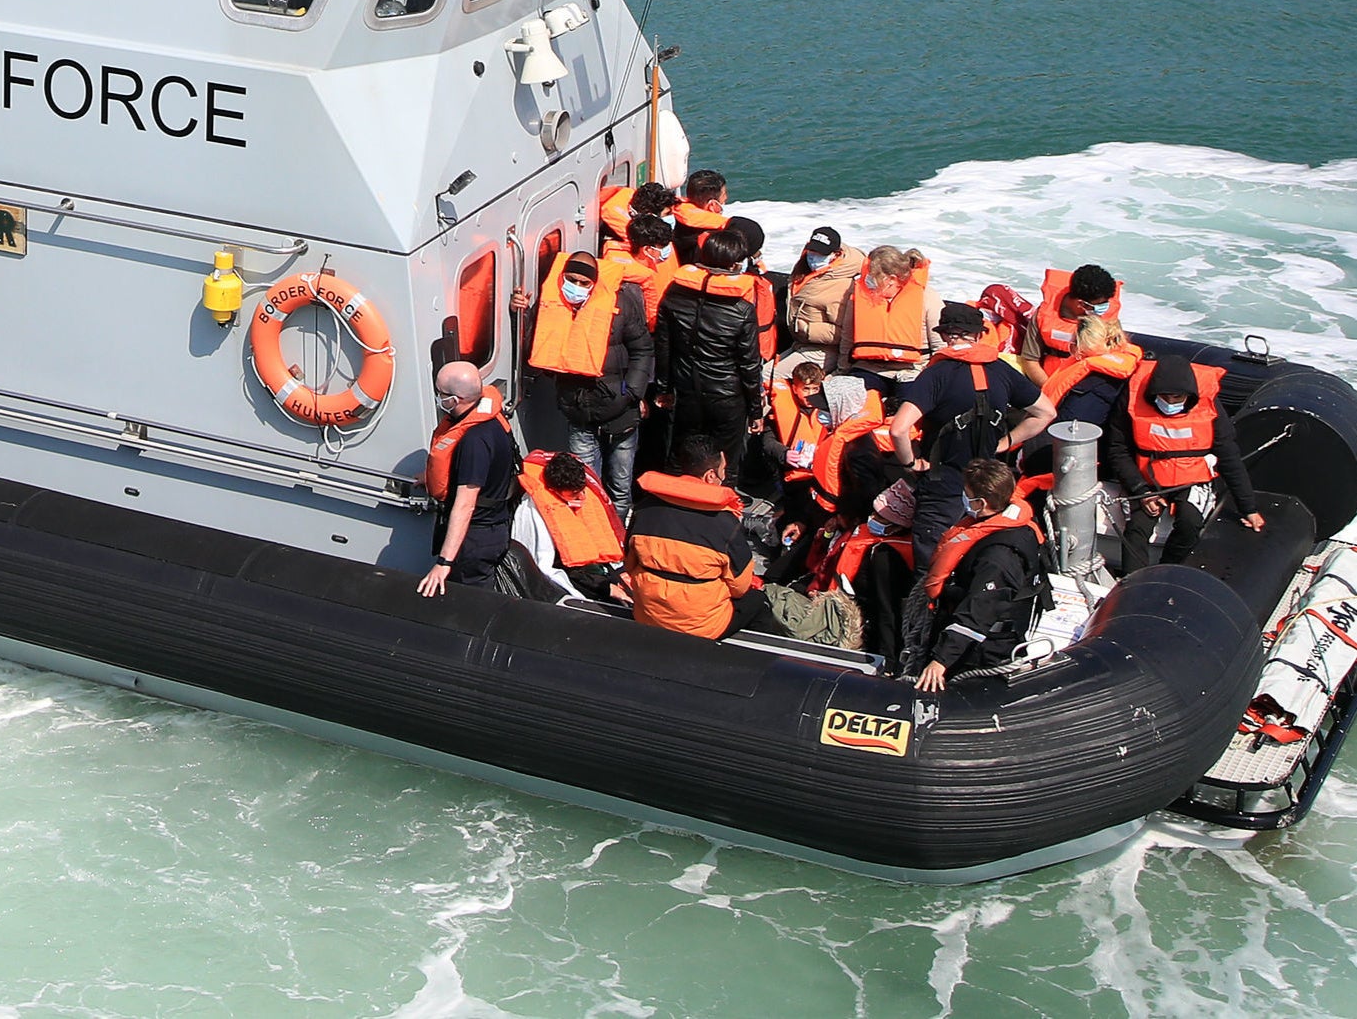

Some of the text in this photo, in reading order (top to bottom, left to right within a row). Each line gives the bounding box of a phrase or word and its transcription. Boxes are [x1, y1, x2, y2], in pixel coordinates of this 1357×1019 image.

[3, 50, 247, 149] FORCE
[258, 285, 364, 324] BORDER FORCE
[291, 399, 354, 423] HUNTER
[827, 710, 903, 741] DELTA
